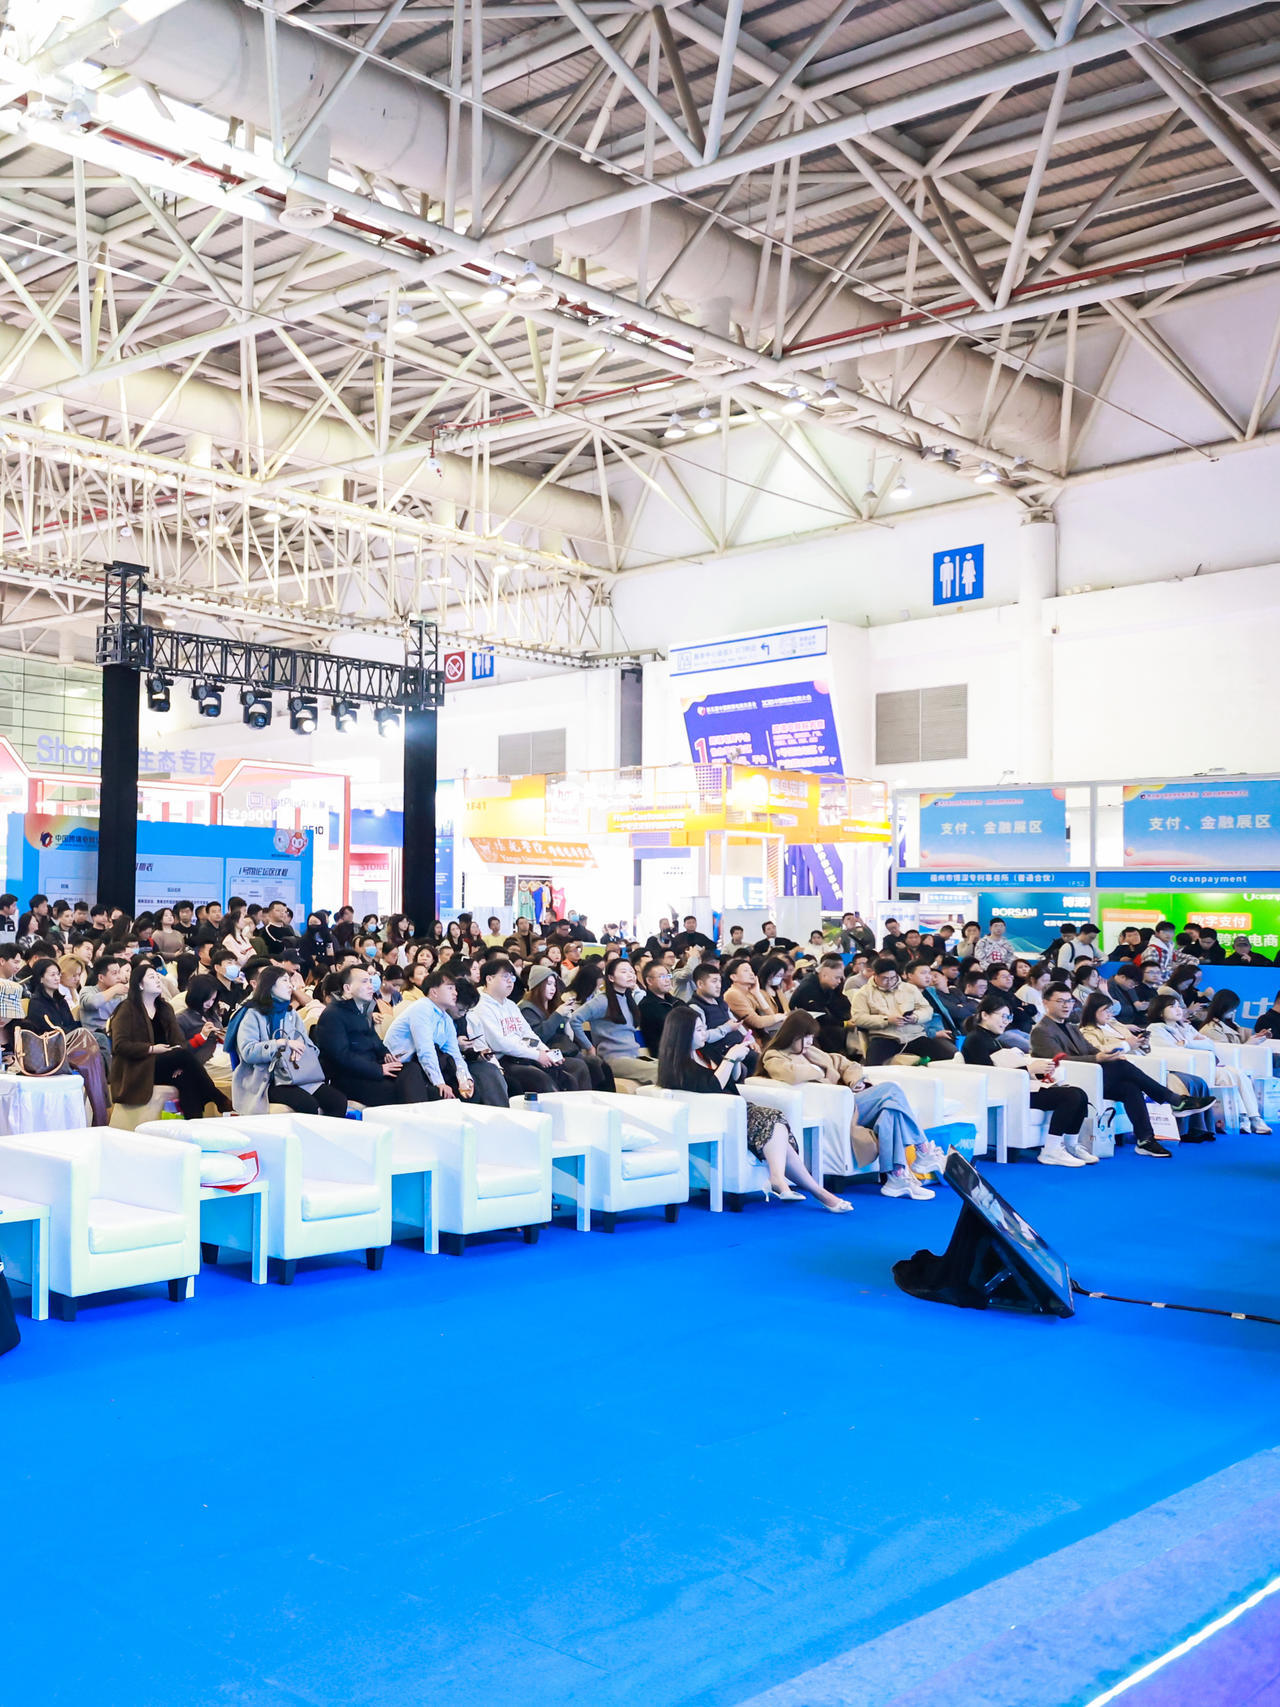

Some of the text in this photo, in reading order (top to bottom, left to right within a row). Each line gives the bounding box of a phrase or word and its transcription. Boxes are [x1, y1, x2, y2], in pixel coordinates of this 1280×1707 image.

[939, 820, 1043, 836] 支付、金融展区
[1148, 813, 1272, 832] 支付、金融展区
[1169, 874, 1248, 884] Oceanpayment
[991, 907, 1038, 918] BORSAM
